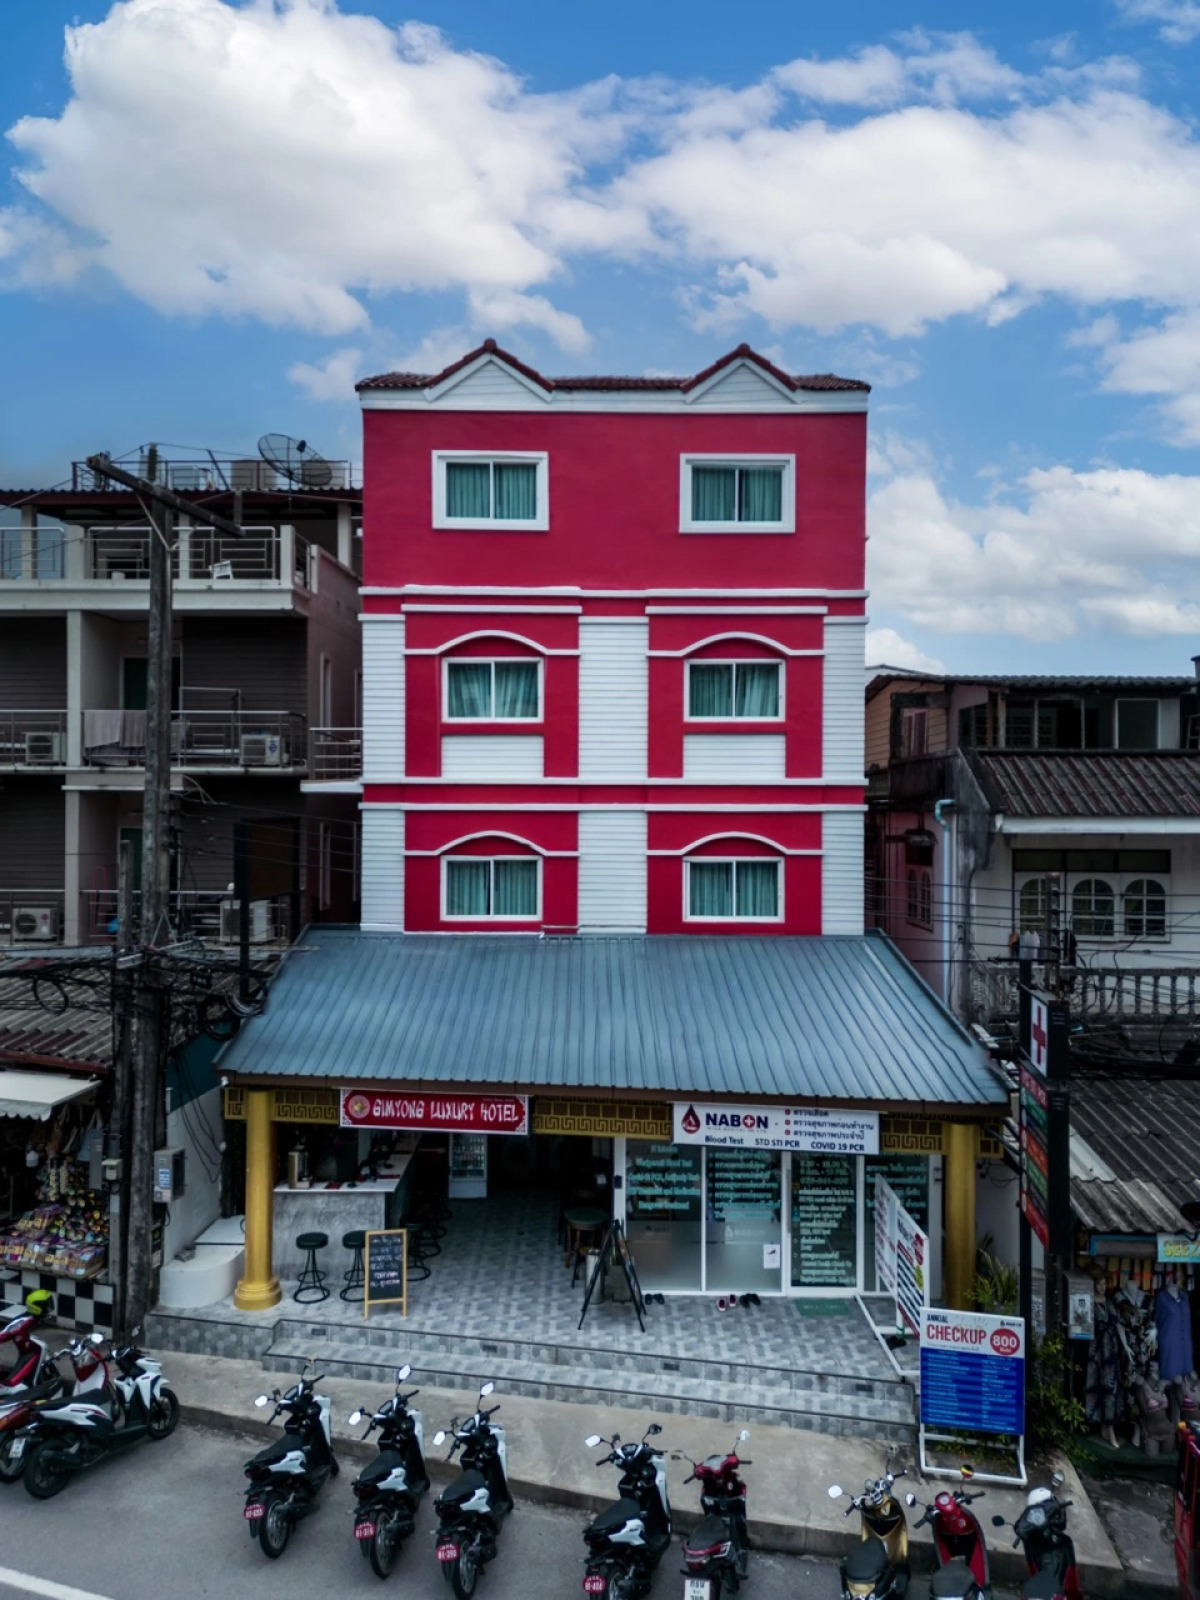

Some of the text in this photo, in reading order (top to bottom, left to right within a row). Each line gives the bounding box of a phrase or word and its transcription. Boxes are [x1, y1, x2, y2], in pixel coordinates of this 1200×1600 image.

[372, 1098, 519, 1122] GIMYONG LUXURY HOTEL
[705, 1113, 769, 1129] NABON
[705, 1135, 744, 1145] Blood Test
[755, 1138, 800, 1148] STD STI PCR
[811, 1141, 865, 1151] COVID 19 PCR
[926, 1324, 987, 1345] CHECKUP
[992, 1335, 1017, 1348] 800
